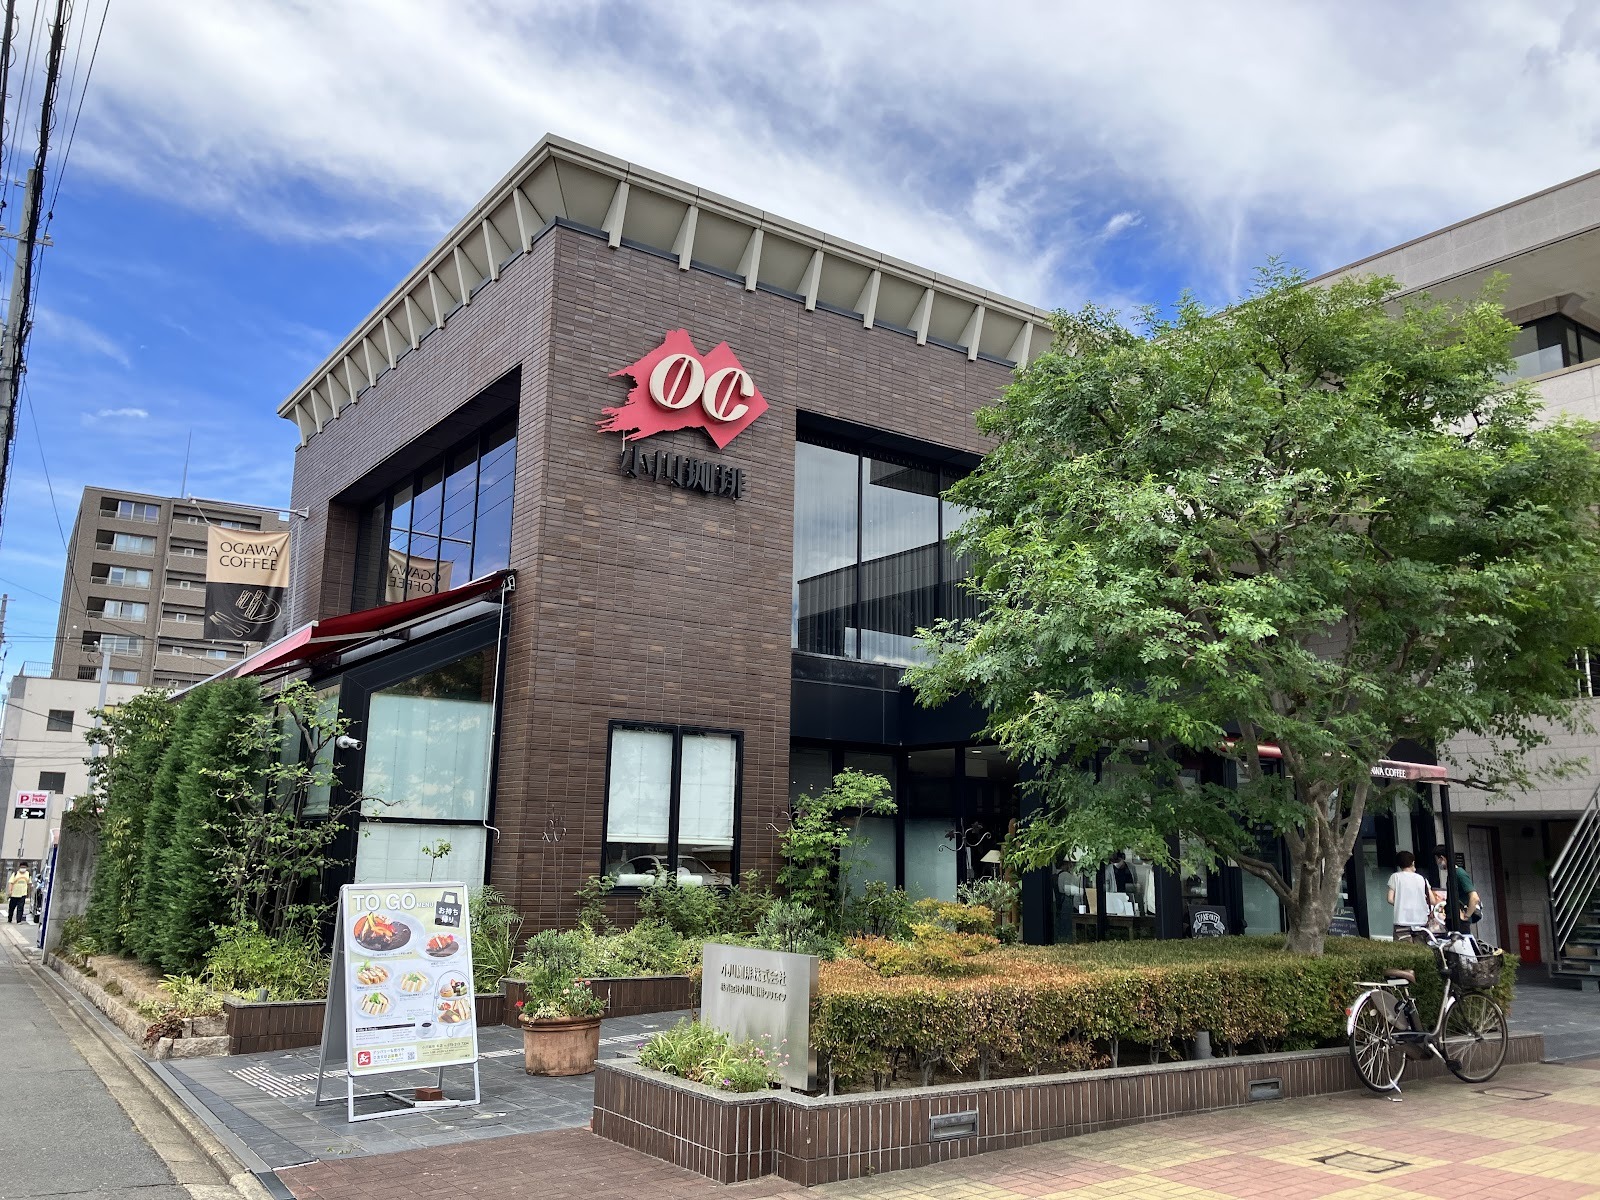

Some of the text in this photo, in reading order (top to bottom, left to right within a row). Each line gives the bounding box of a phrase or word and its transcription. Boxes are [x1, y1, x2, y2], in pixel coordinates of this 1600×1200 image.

[649, 353, 755, 422] OC
[619, 445, 746, 500] 小川珈琲
[220, 541, 279, 558] OGAWA
[219, 555, 278, 571] COFFEE
[1385, 767, 1407, 778] COFFEE
[352, 893, 381, 911] TO
[385, 892, 417, 910] GO
[438, 906, 459, 915] お持ち
